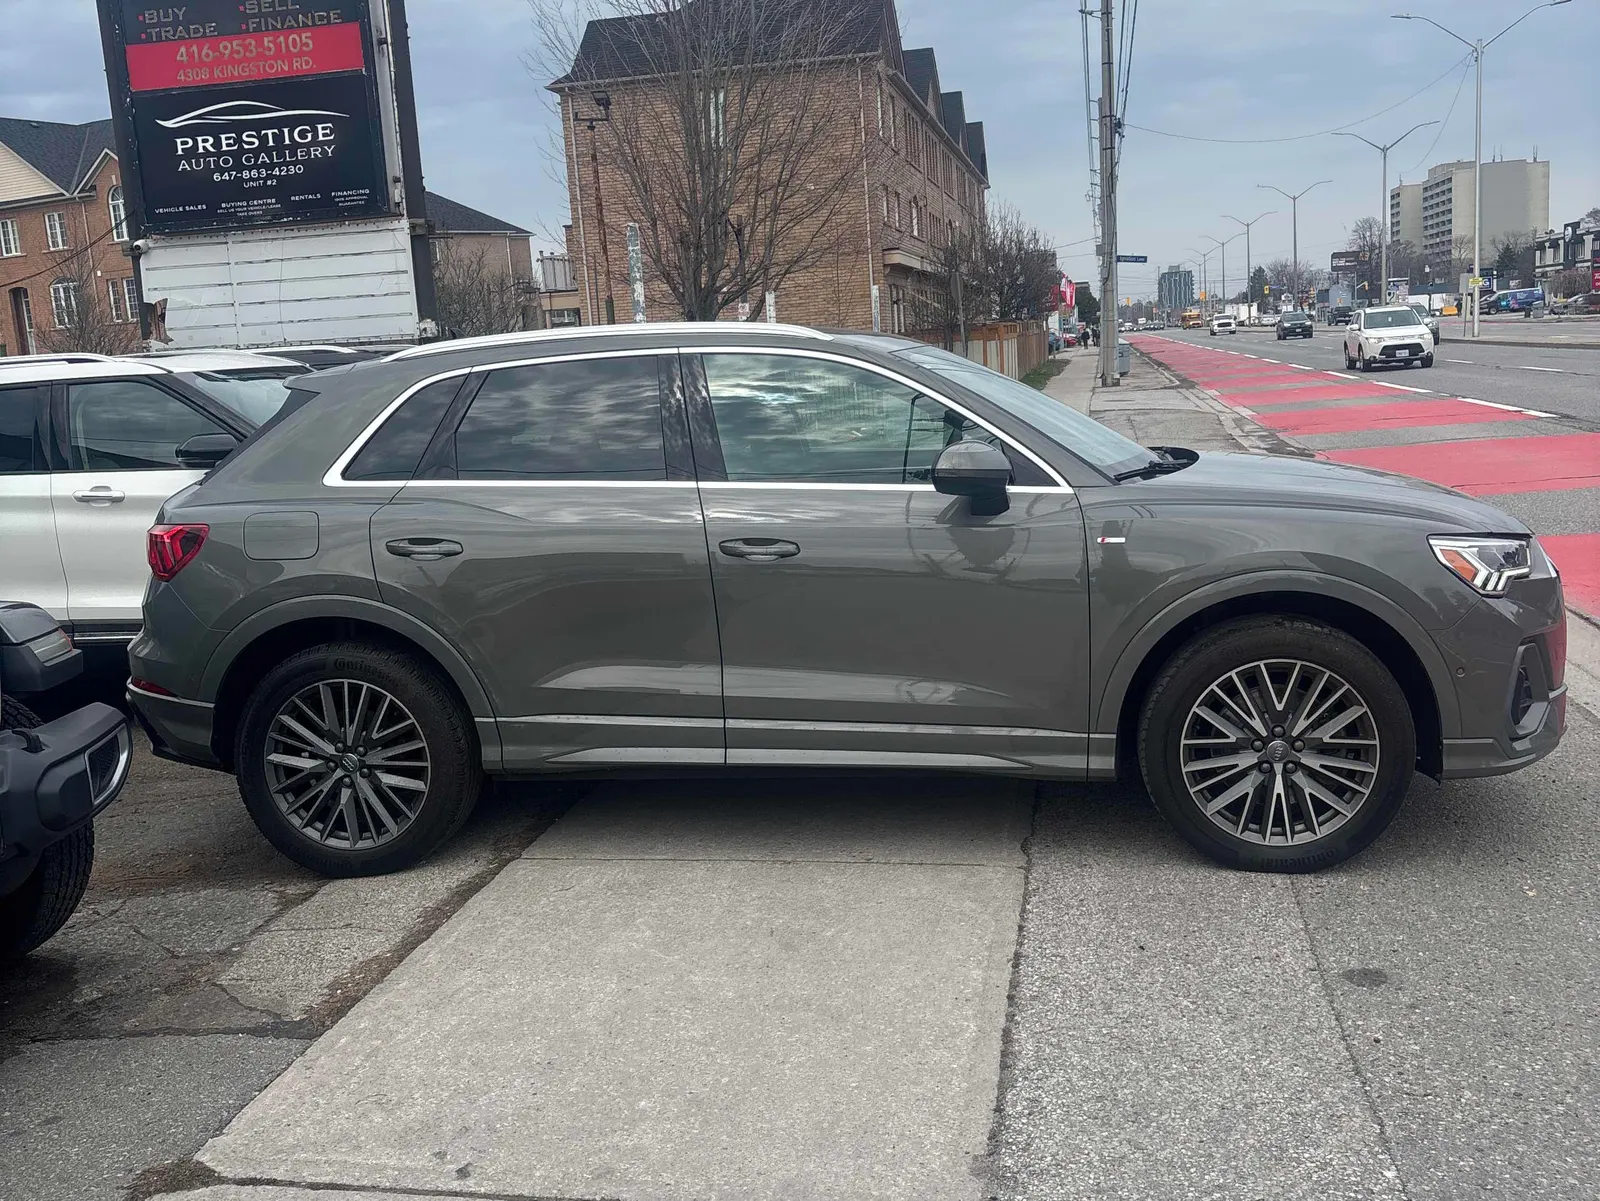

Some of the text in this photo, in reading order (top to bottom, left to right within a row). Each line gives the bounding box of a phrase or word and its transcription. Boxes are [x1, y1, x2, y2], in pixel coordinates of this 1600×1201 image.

[144, 6, 187, 23] BUY
[245, 0, 300, 13] SELL
[248, 9, 342, 32] FINANCE
[147, 22, 218, 41] TRADE
[176, 32, 313, 63] 416-953-5105
[177, 56, 317, 82] 4308 KINGSTON RD.
[173, 122, 336, 156] PRESTIGE
[177, 144, 336, 172] AUTO GALLERY
[213, 164, 304, 182] 647-863-4230
[243, 180, 264, 188] UNIT
[331, 188, 370, 197] FINANCING
[290, 193, 321, 201] RENTALS
[154, 206, 184, 214] VEHICLE
